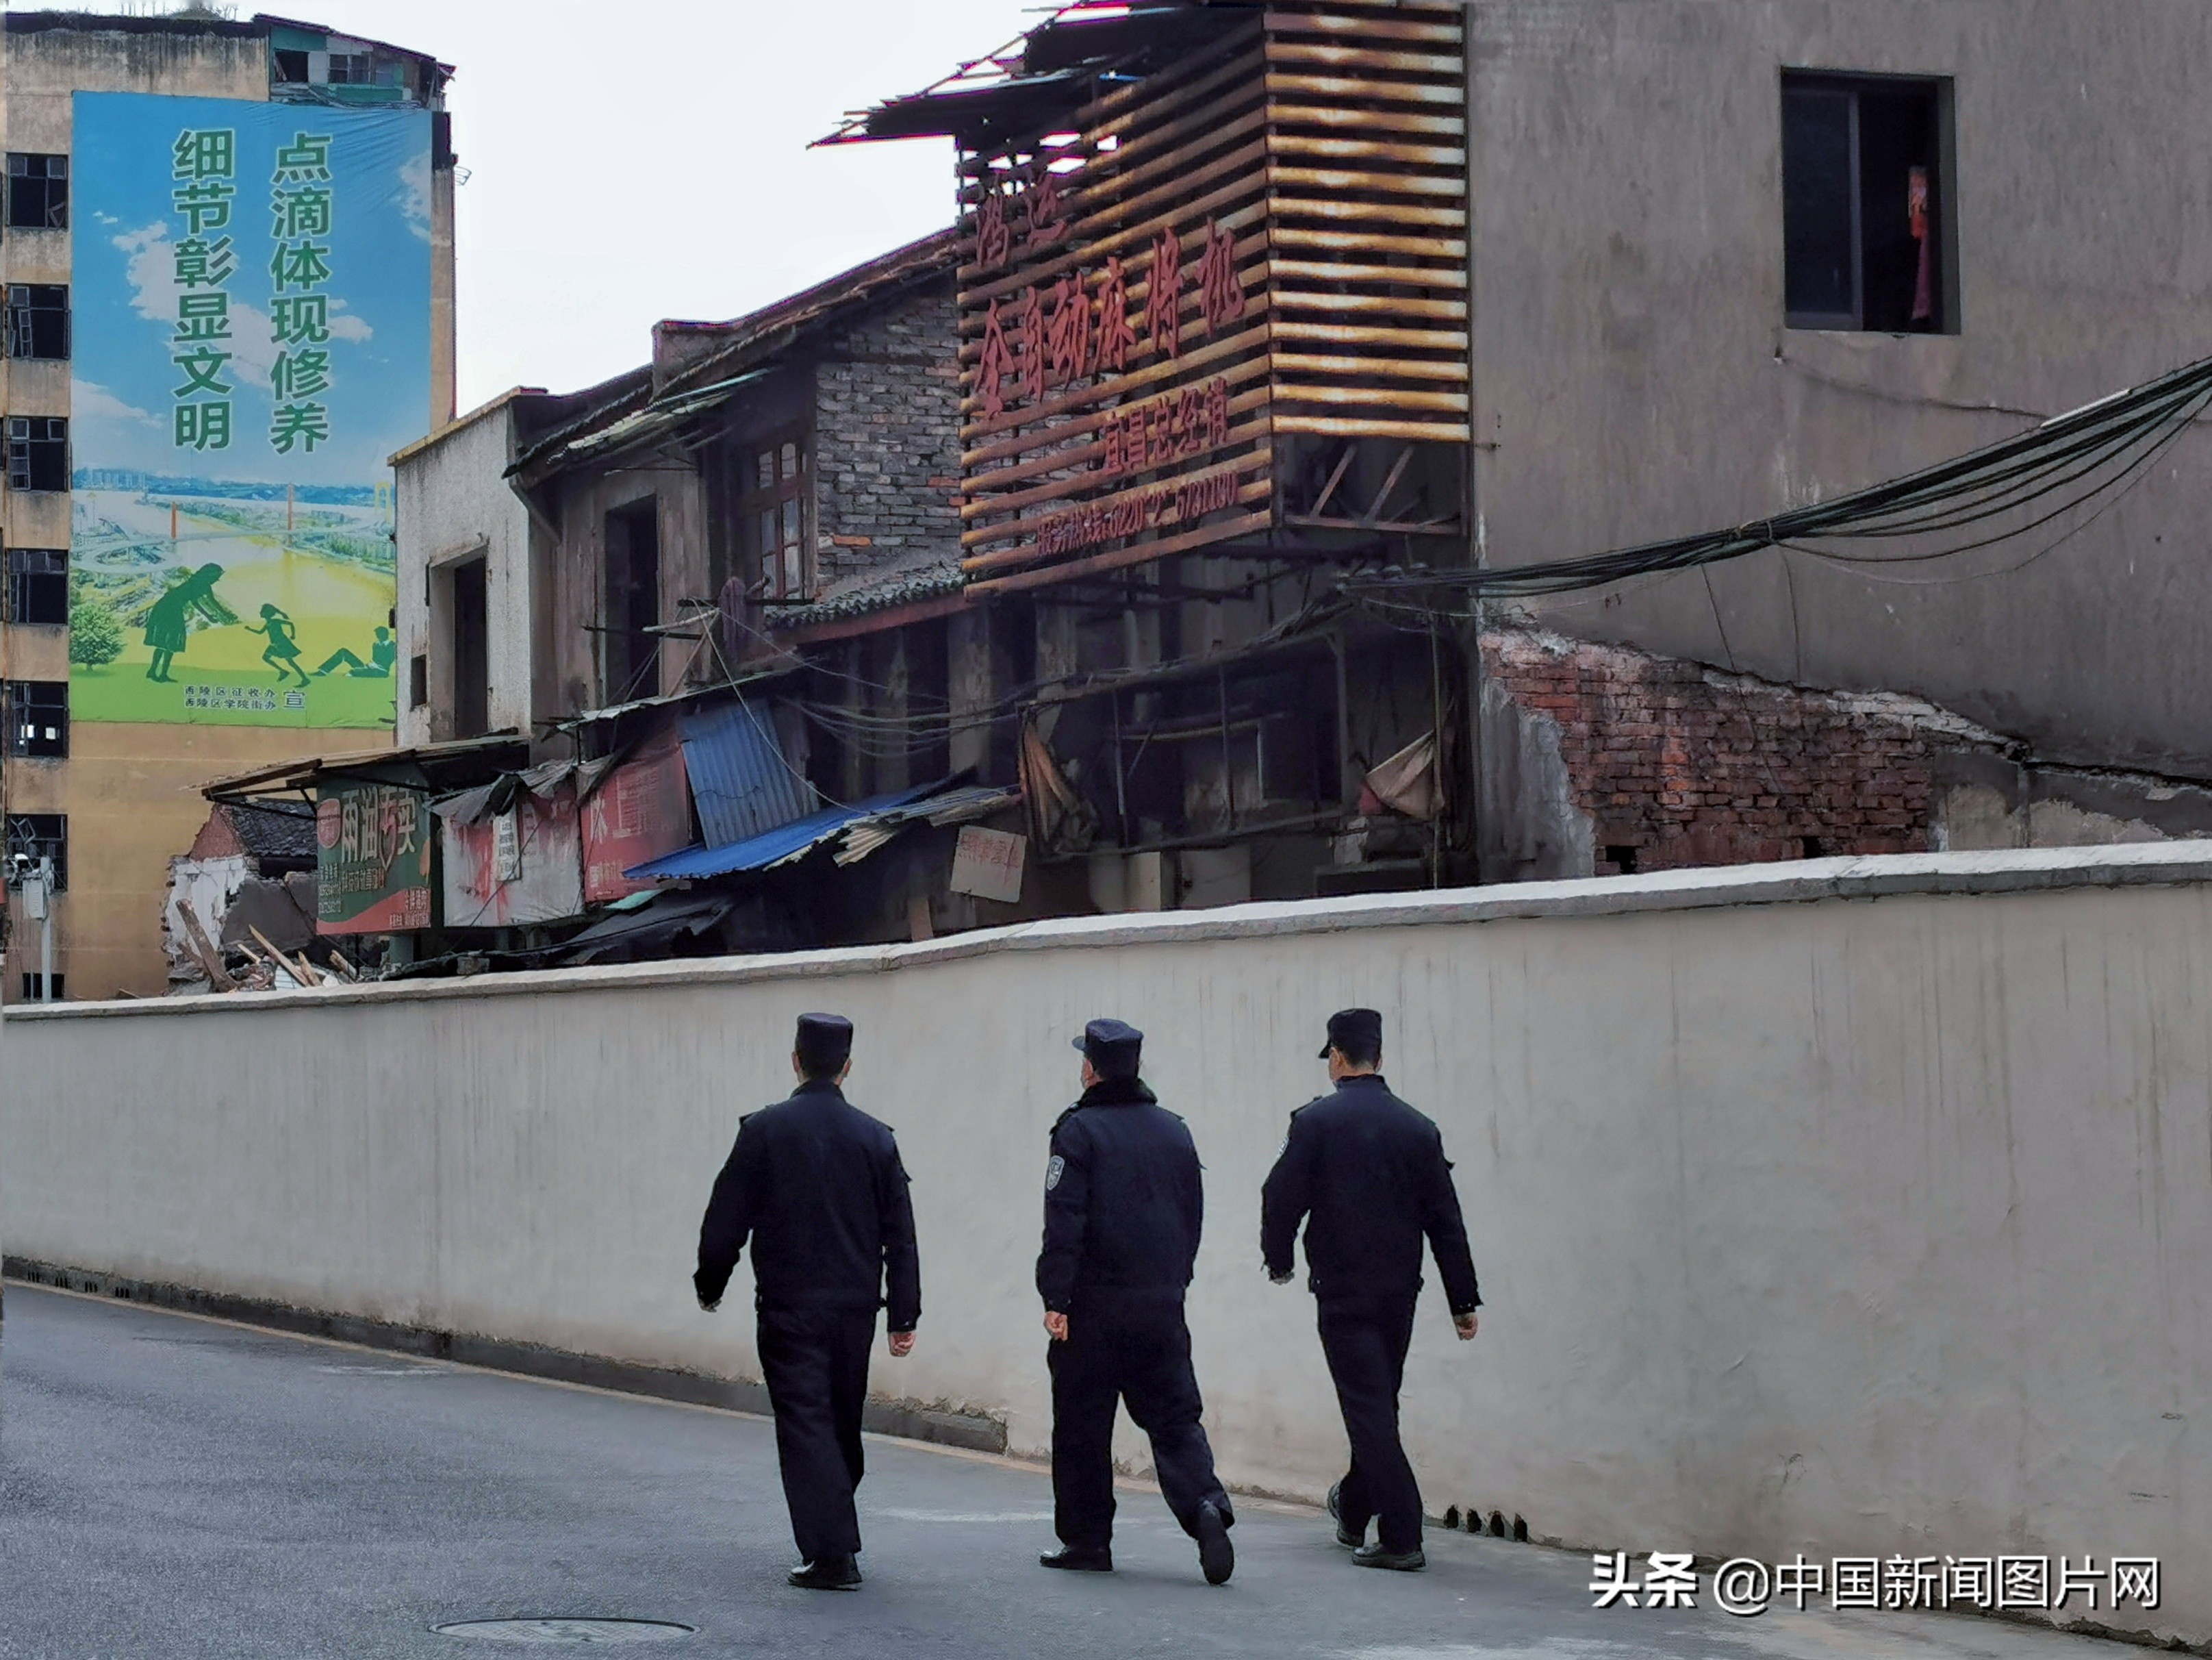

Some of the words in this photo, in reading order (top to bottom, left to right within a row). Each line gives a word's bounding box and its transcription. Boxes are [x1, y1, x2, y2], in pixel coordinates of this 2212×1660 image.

[173, 129, 235, 451] 细节彰显文明
[270, 131, 333, 454] 点滴体现修养
[975, 216, 1245, 419] 全自动麻将机
[1102, 376, 1229, 475] 宜昌总经销
[283, 690, 305, 709] 宣
